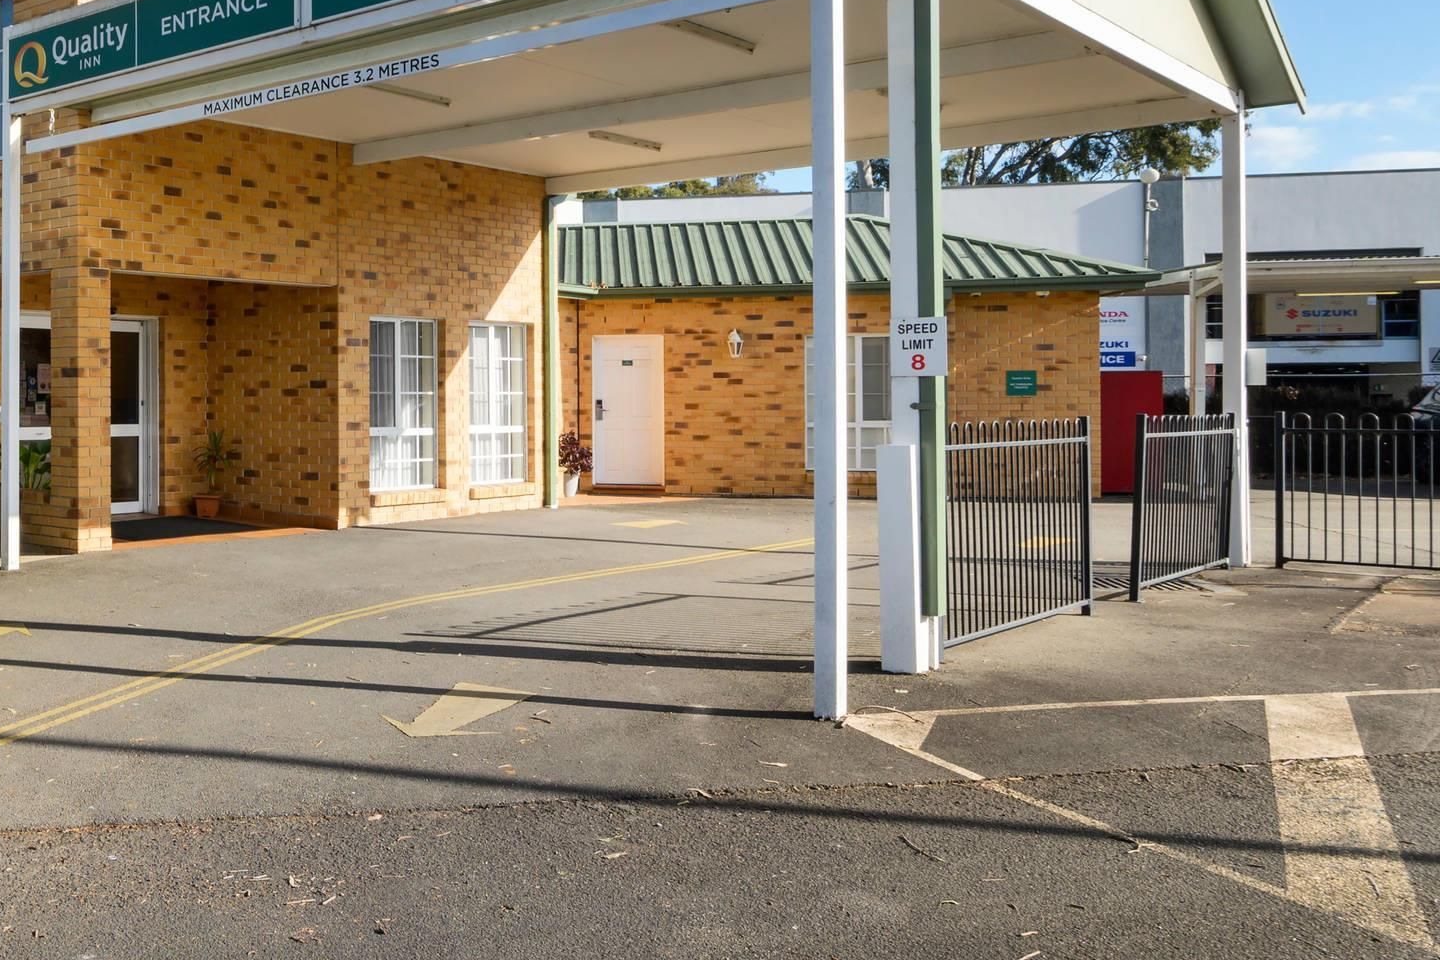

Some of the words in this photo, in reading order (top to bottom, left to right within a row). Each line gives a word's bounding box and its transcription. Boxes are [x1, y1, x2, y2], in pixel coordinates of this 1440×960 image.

[52, 22, 128, 65] Quality
[14, 41, 49, 87] Q
[79, 55, 101, 70] INN
[203, 93, 263, 115] MAXIMUM
[266, 73, 349, 102] CLEARANCE
[354, 68, 374, 84] 3.2
[378, 54, 440, 79] METRES
[1301, 309, 1357, 318] SUZUKI
[897, 323, 938, 334] SPEED
[902, 339, 934, 350] LIMIT
[911, 354, 926, 371] 8
